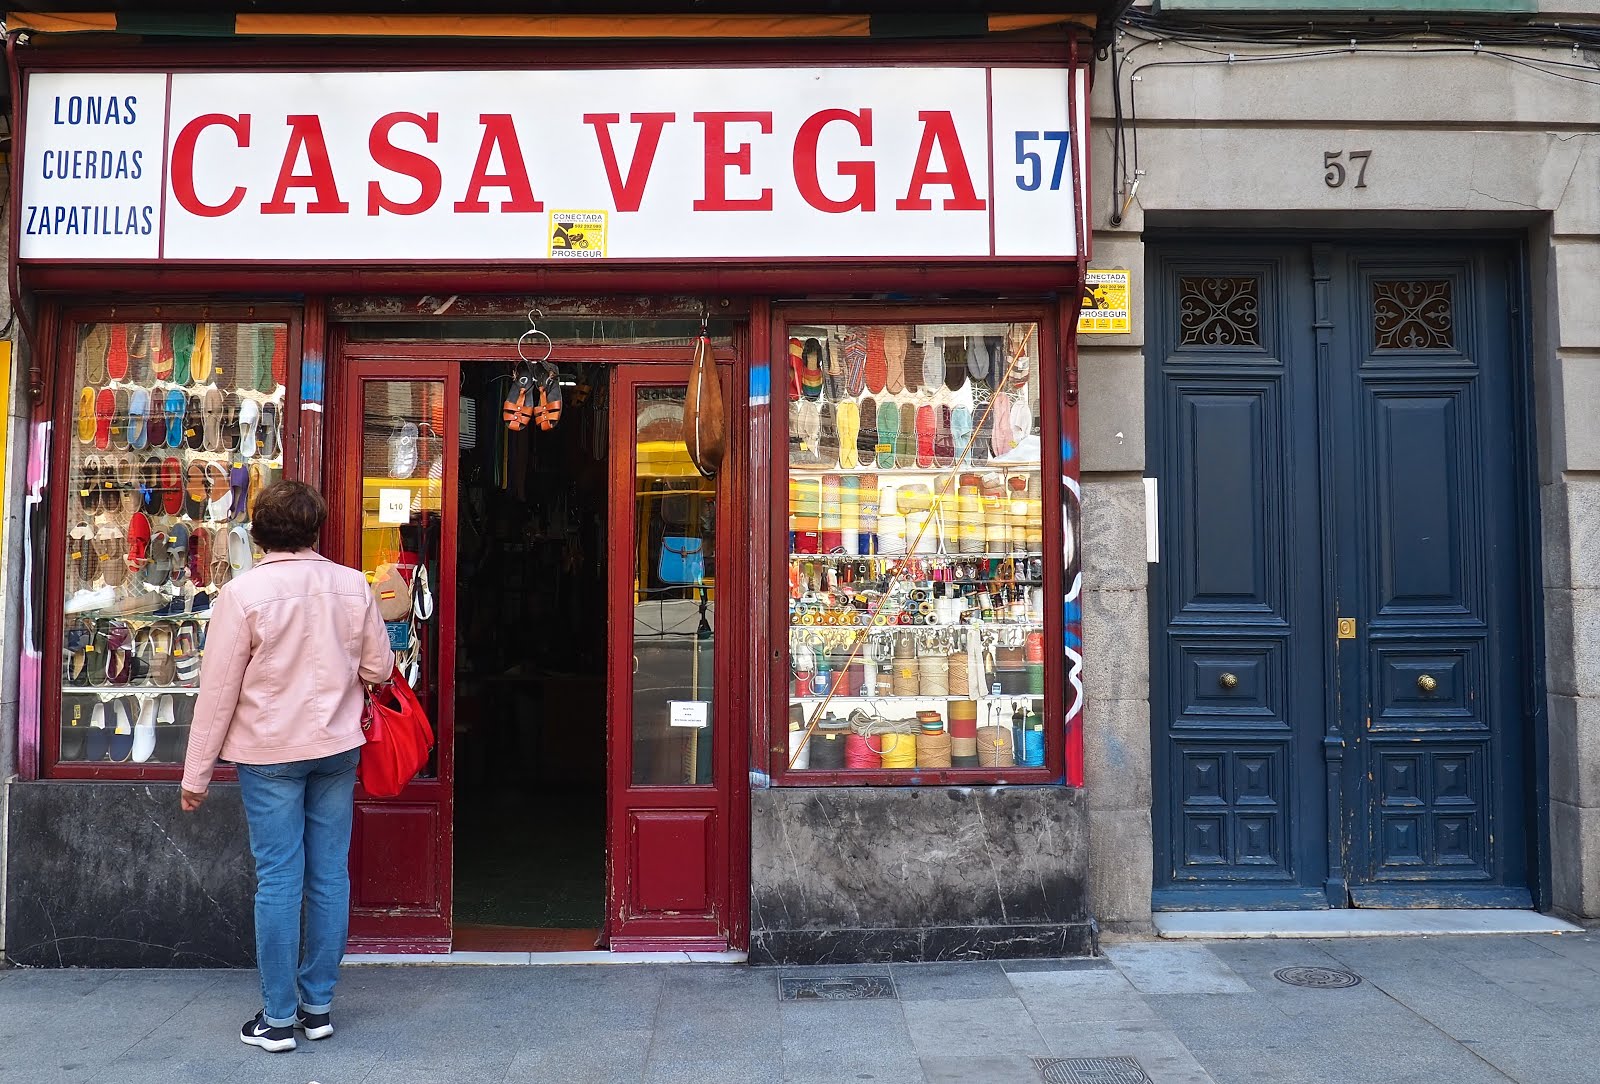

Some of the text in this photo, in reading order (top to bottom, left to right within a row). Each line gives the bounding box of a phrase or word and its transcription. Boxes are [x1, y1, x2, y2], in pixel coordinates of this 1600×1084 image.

[53, 95, 138, 125] LONAS
[42, 150, 143, 180] CUERDAS
[170, 108, 987, 217] CASA VEGA
[1015, 131, 1069, 191] 57
[1324, 150, 1372, 188] 57
[26, 205, 153, 236] ZAPATILLAS
[551, 250, 602, 258] PROSEGUR
[1080, 310, 1127, 318] PROSEGUR
[389, 502, 403, 511] L10
